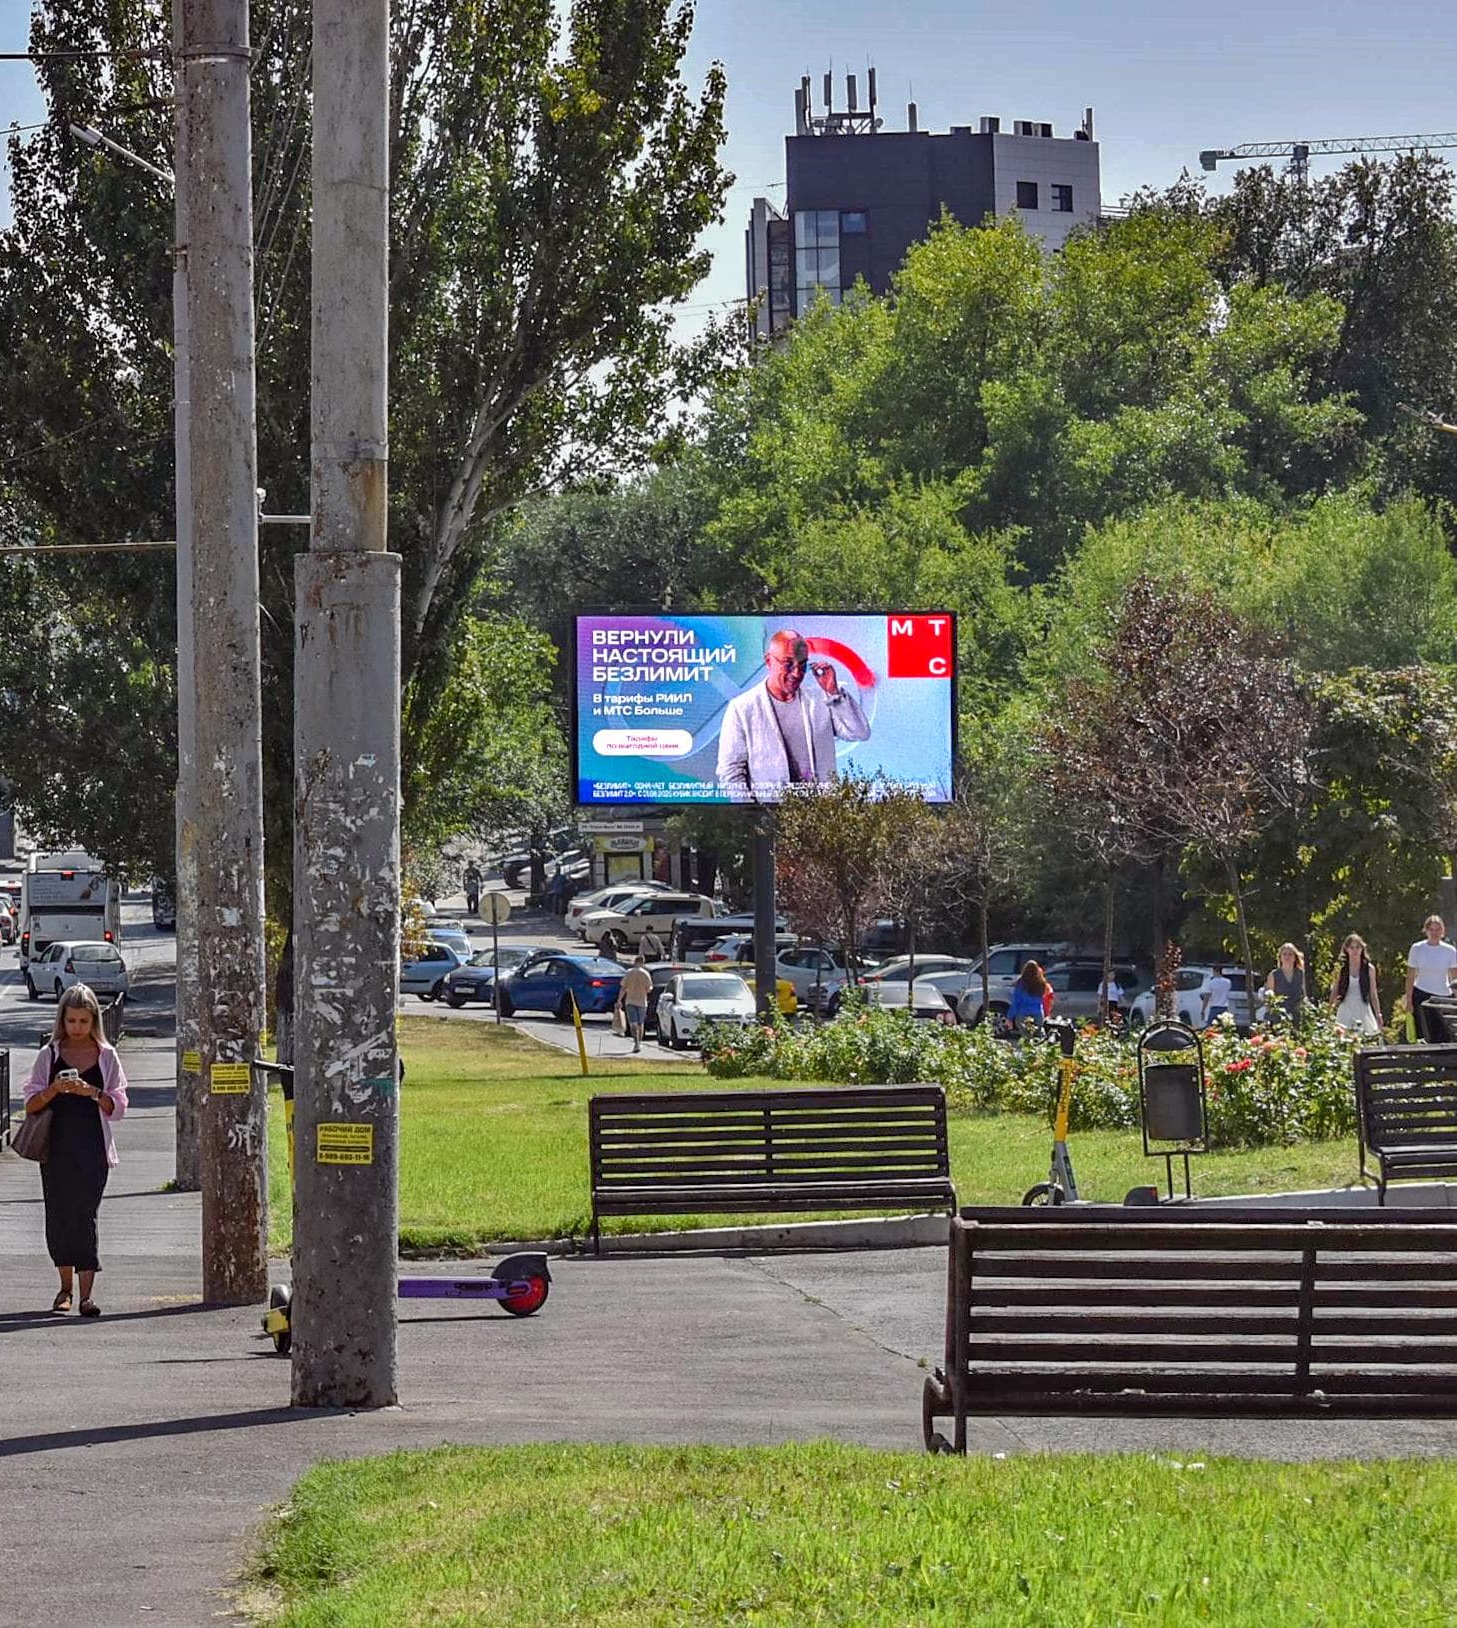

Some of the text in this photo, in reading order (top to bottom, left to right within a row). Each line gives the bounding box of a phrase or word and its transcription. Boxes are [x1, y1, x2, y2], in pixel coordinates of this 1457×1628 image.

[592, 630, 695, 645] ВЕРНУЛИ
[592, 644, 736, 665] НАСТОЯЩИЙ
[592, 666, 714, 682] БЕЗЛИМИТ
[592, 693, 693, 705] В тарифы РИИЛ
[592, 705, 684, 716] и МТС Больше
